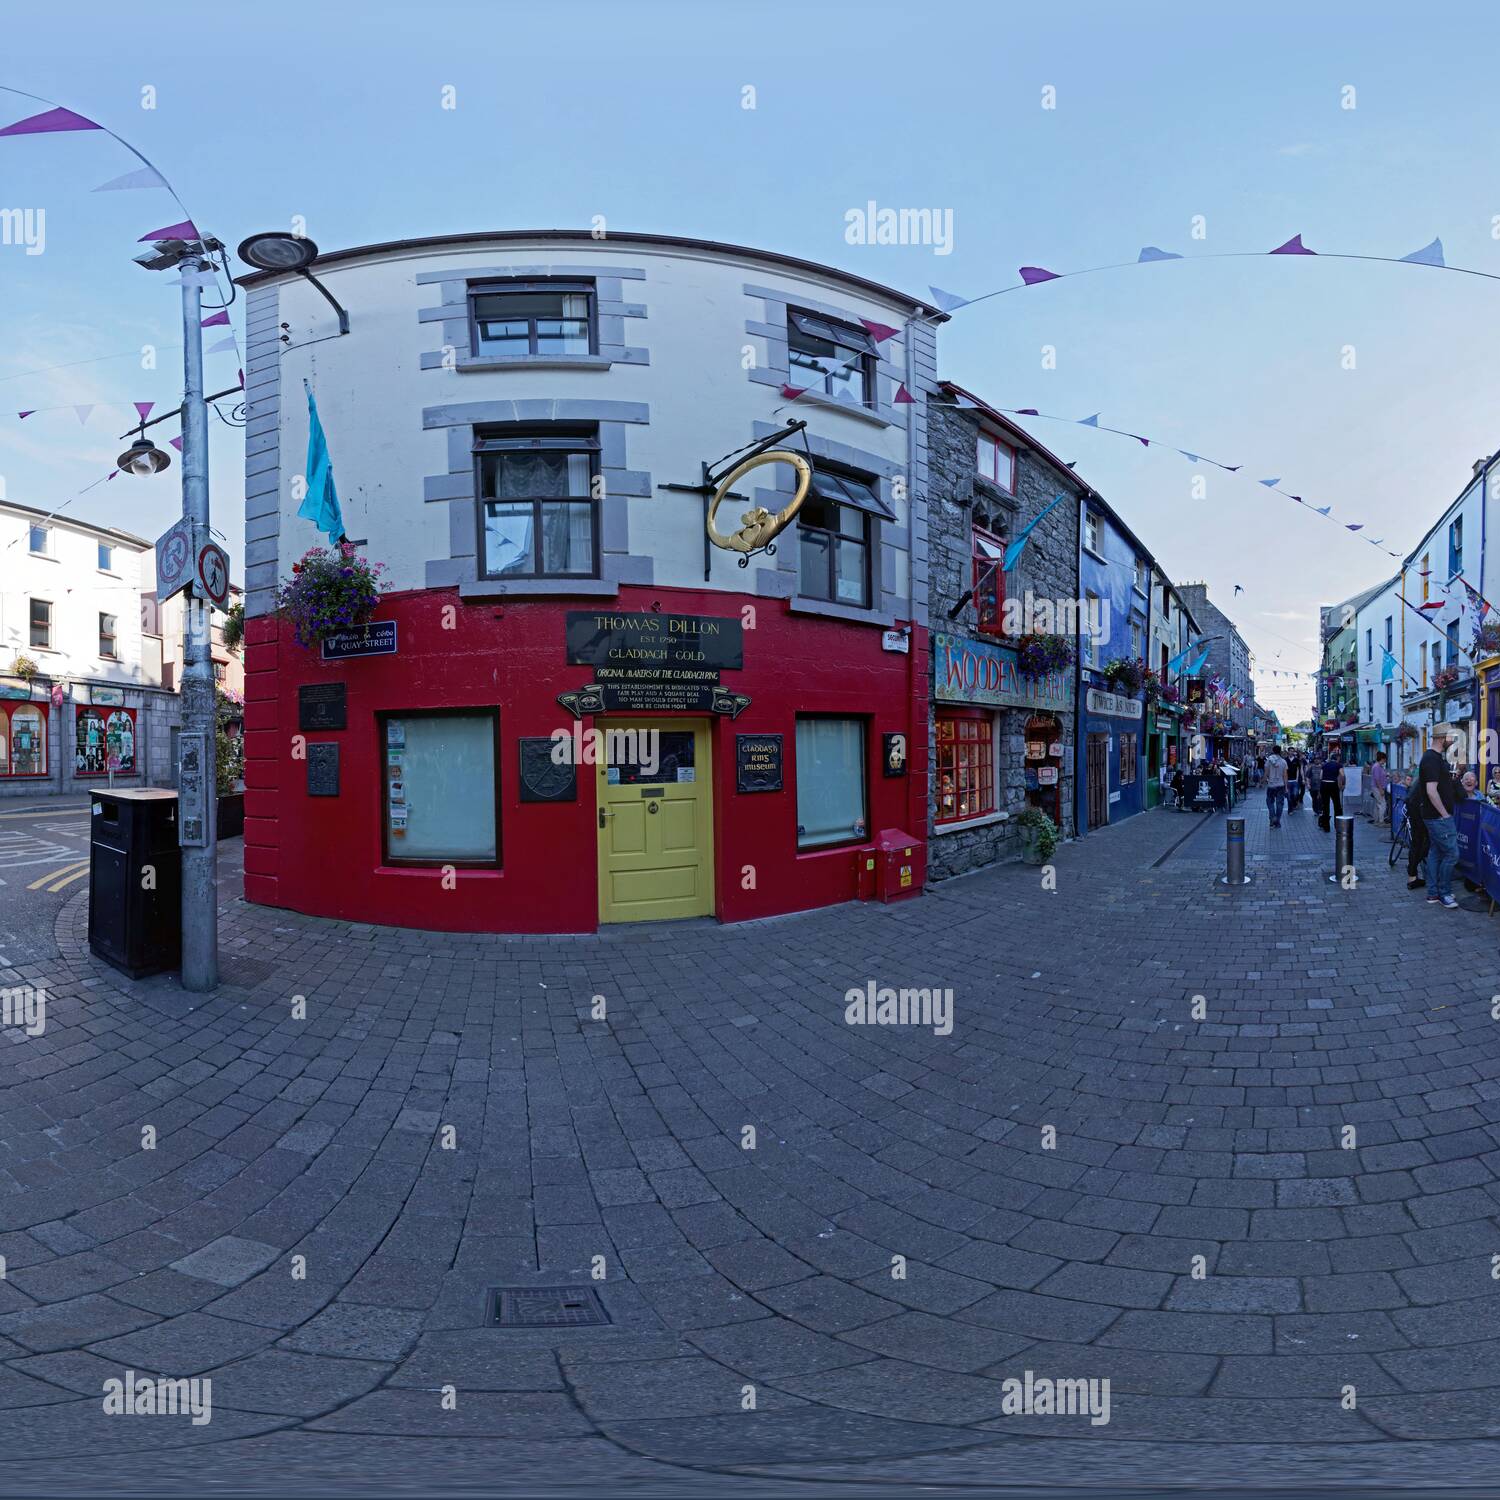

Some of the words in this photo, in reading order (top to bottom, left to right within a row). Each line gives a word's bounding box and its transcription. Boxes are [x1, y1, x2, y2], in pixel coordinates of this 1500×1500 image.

[594, 616, 659, 632] THOMAS
[669, 620, 719, 635] DILLON
[341, 641, 360, 650] QUAY
[365, 638, 393, 648] STREET
[660, 636, 677, 644] 1750
[609, 649, 668, 660] CLADDAGH
[675, 651, 705, 661] GOLD
[597, 669, 624, 677] ORIGINAL
[625, 669, 652, 678] MAKERS
[652, 670, 660, 678] OF
[662, 670, 672, 678] THE
[673, 670, 704, 680] CLADDAGH
[945, 645, 1019, 694] WOODEN
[1092, 693, 1113, 710] TWICE
[1115, 698, 1123, 713] AS
[1124, 703, 1136, 714] NICE
